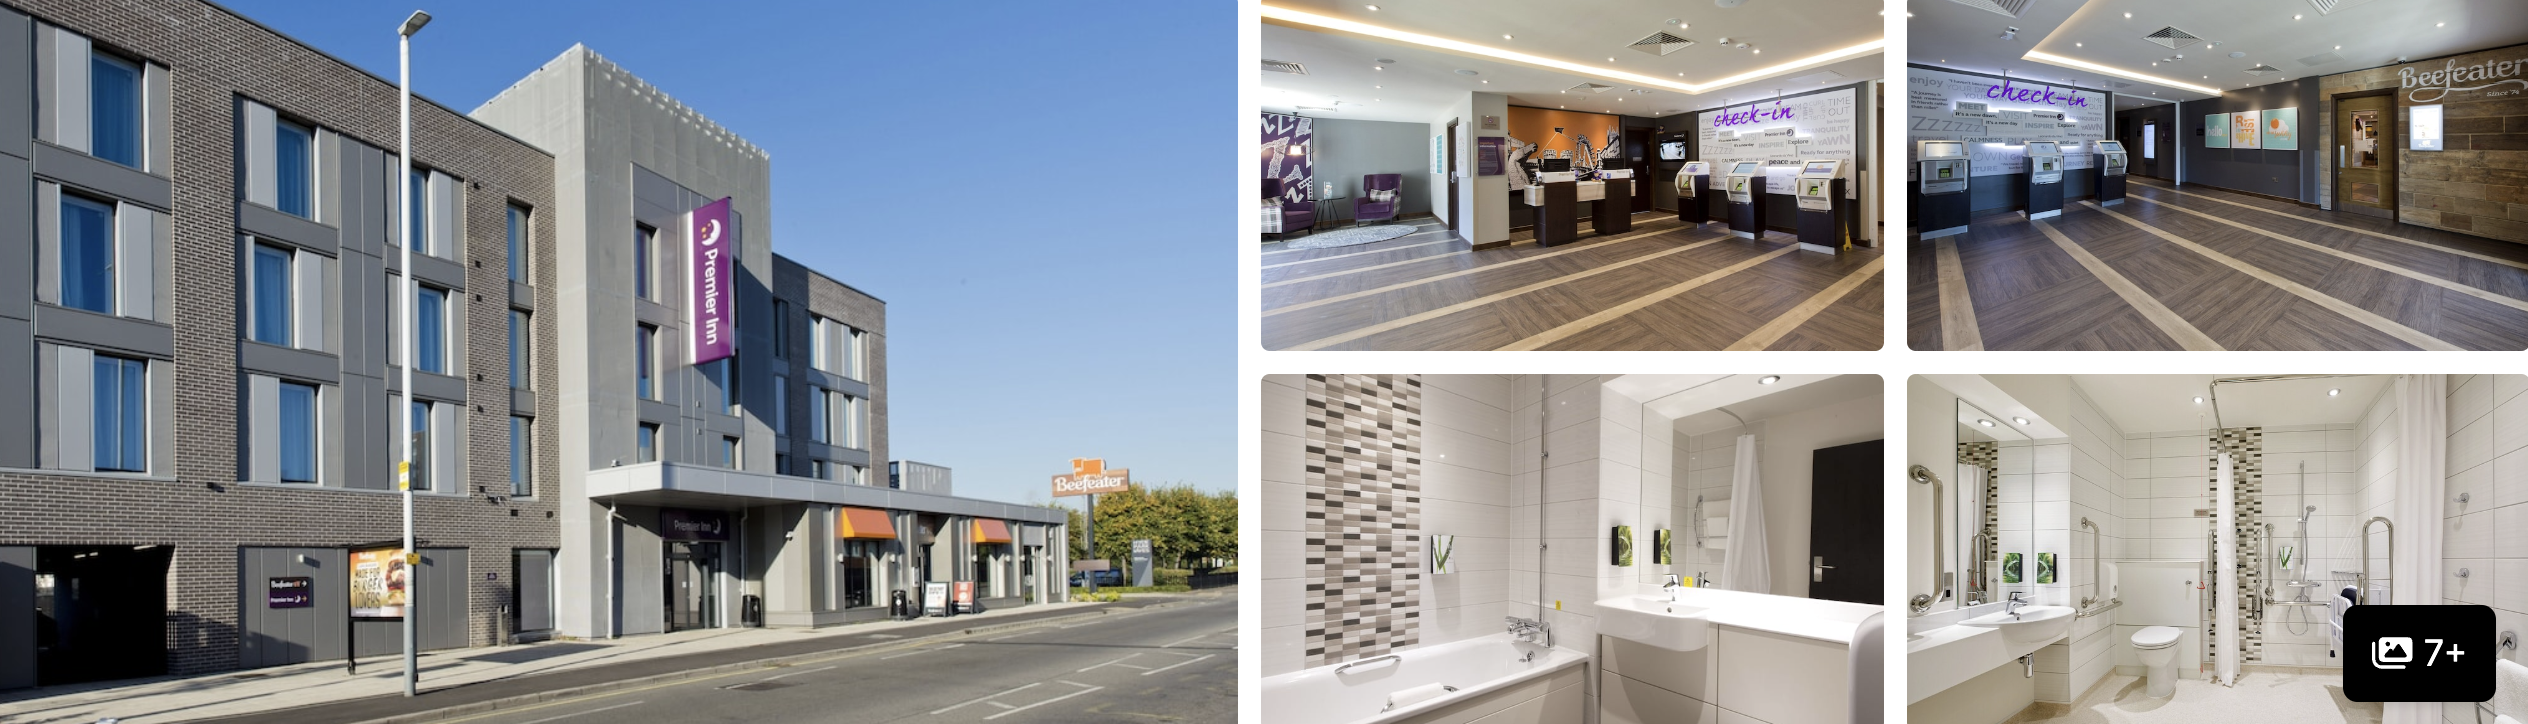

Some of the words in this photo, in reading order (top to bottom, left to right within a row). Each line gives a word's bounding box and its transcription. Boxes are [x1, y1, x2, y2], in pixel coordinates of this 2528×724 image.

[2398, 58, 2528, 92] Beefeater
[1910, 77, 1943, 87] enjoy
[1987, 79, 2088, 107] check-in
[1828, 96, 1851, 106] TIME
[1714, 100, 1795, 127] check-in
[1828, 106, 1851, 116] OUT
[2003, 111, 2028, 119] VISIT
[1802, 125, 1850, 134] TRANQUILITY
[1758, 141, 1784, 149] INSPIRE
[1818, 134, 1850, 146] YAWN
[1972, 151, 2008, 161] OWN
[704, 248, 718, 315] Premier
[706, 317, 719, 345] Inn
[1054, 476, 1125, 493] Beefeater
[674, 520, 699, 532] Premier
[701, 522, 711, 532] Inn
